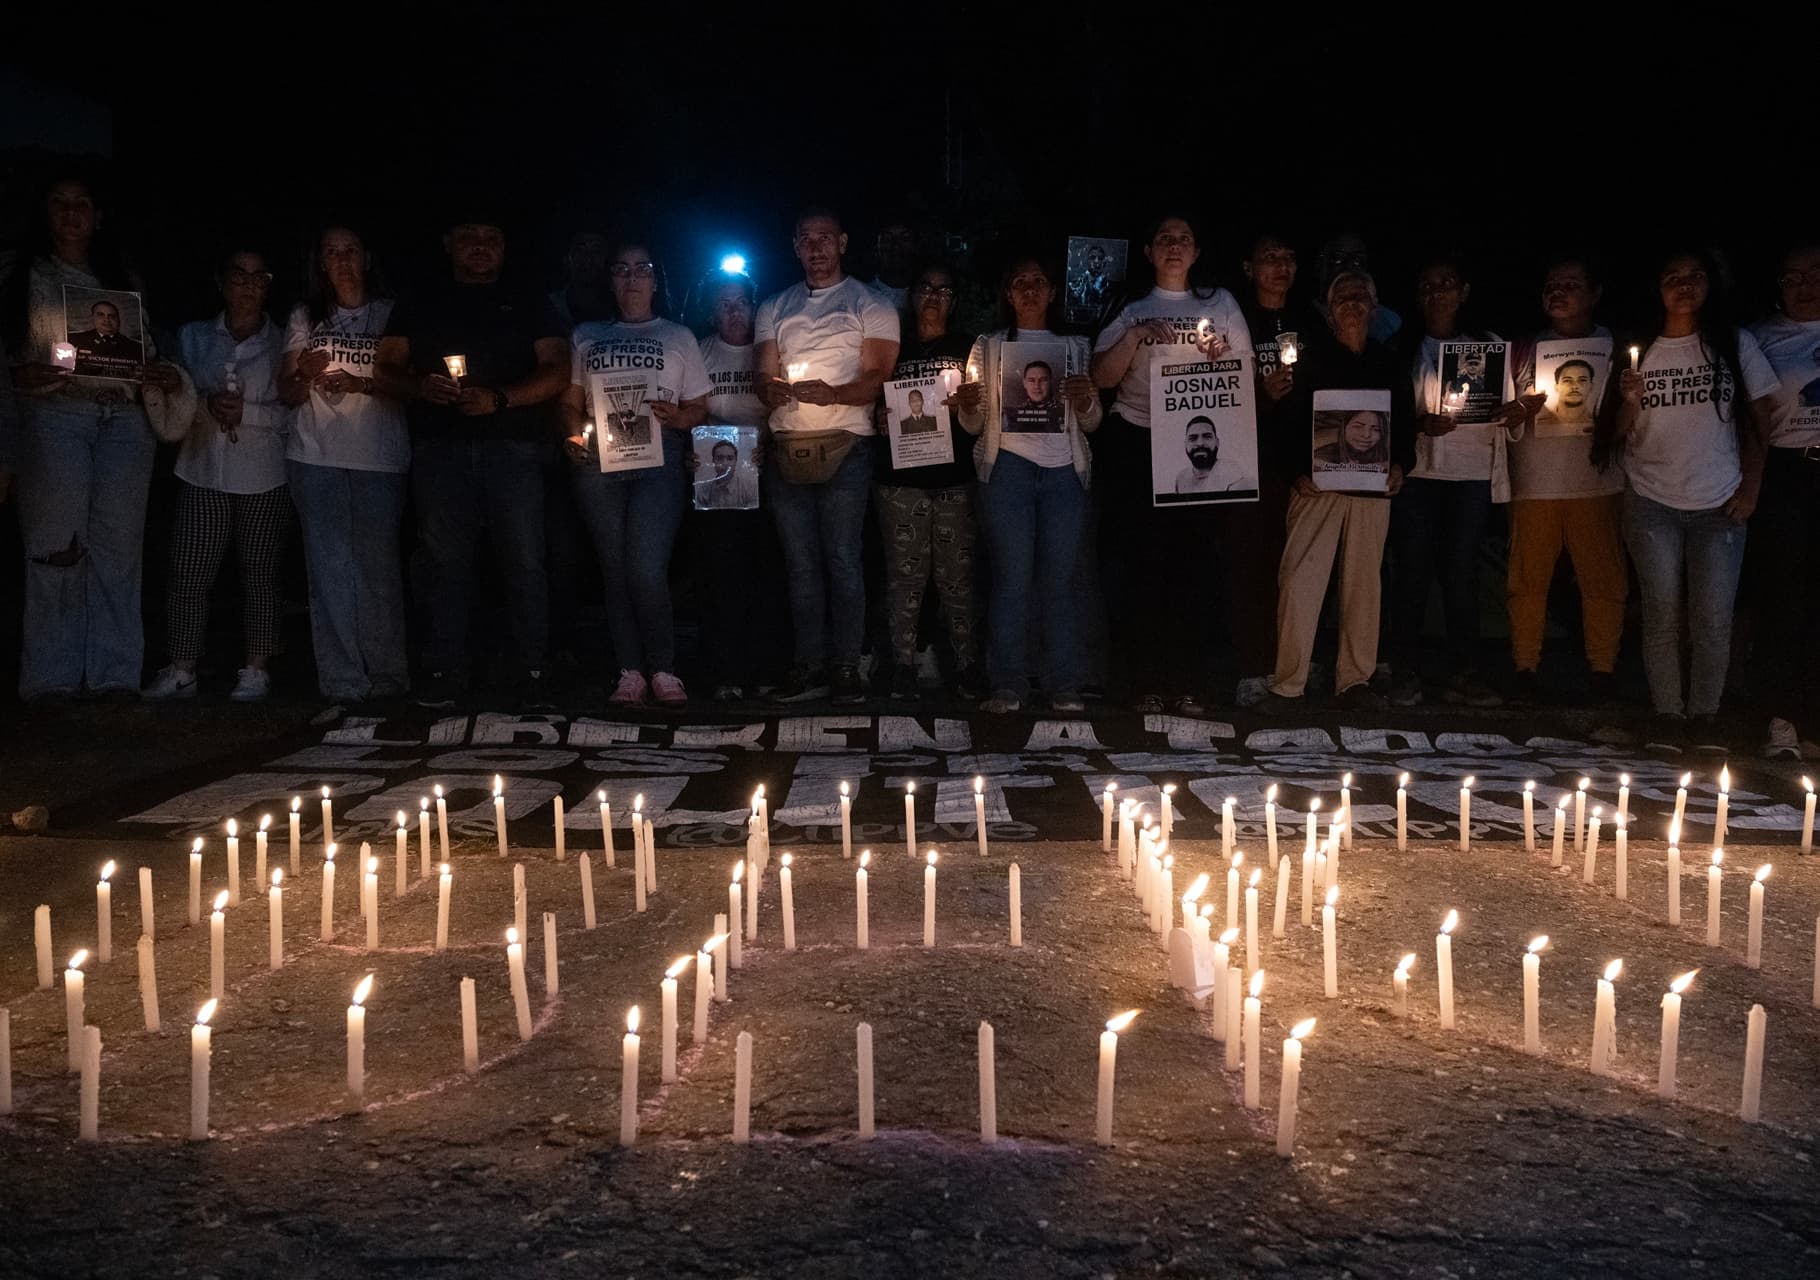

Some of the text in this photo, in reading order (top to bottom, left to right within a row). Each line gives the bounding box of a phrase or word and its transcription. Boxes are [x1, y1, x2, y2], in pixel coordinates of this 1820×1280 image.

[332, 338, 380, 350] PRESOS
[611, 344, 664, 356] PRESOS
[1445, 344, 1505, 354] LIBERTAD
[586, 353, 664, 372] POLÍTICOS
[1164, 361, 1240, 375] LIBERTAD PARA
[1644, 368, 1683, 378] IBEREN
[894, 379, 936, 389] LIBERTAD
[1165, 376, 1240, 394] JOSNAR
[1672, 374, 1731, 389] PRESOS
[1165, 394, 1241, 411] BADUEL
[1640, 388, 1731, 411] POLÍTICOS
[321, 713, 972, 752] LIBEREN
[1024, 720, 1114, 750] A
[261, 745, 729, 774] LOS
